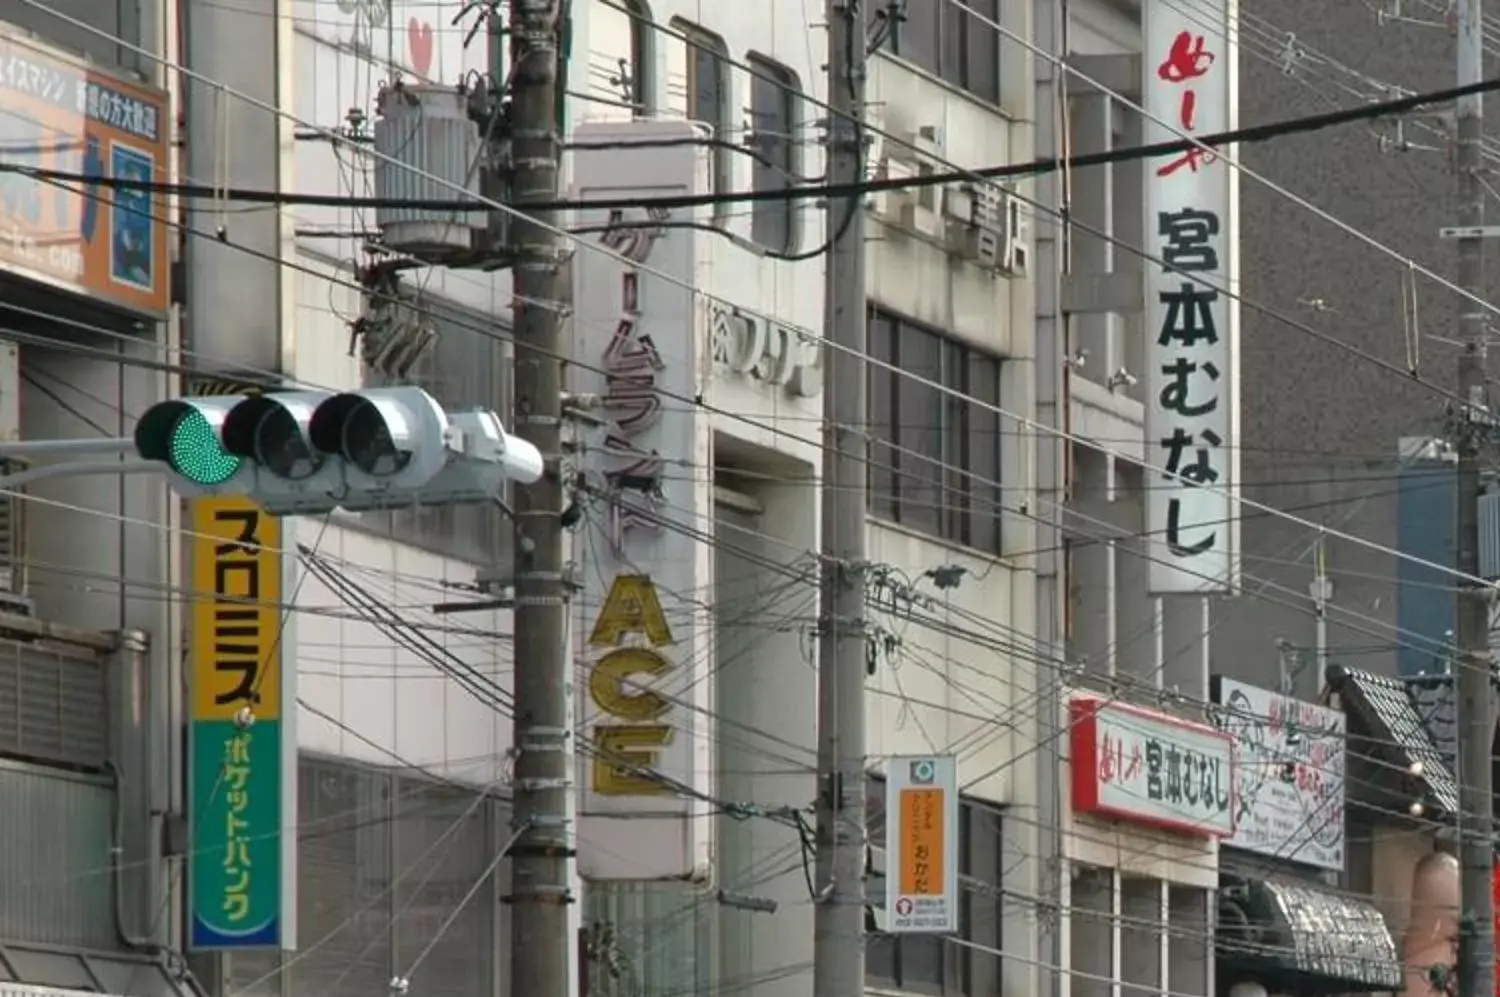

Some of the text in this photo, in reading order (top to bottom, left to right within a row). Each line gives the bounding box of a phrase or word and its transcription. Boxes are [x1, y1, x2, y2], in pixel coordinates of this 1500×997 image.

[1157, 31, 1222, 556] めしや 宮本むなし
[588, 573, 676, 797] ACE
[222, 732, 252, 921] ポケットバンク
